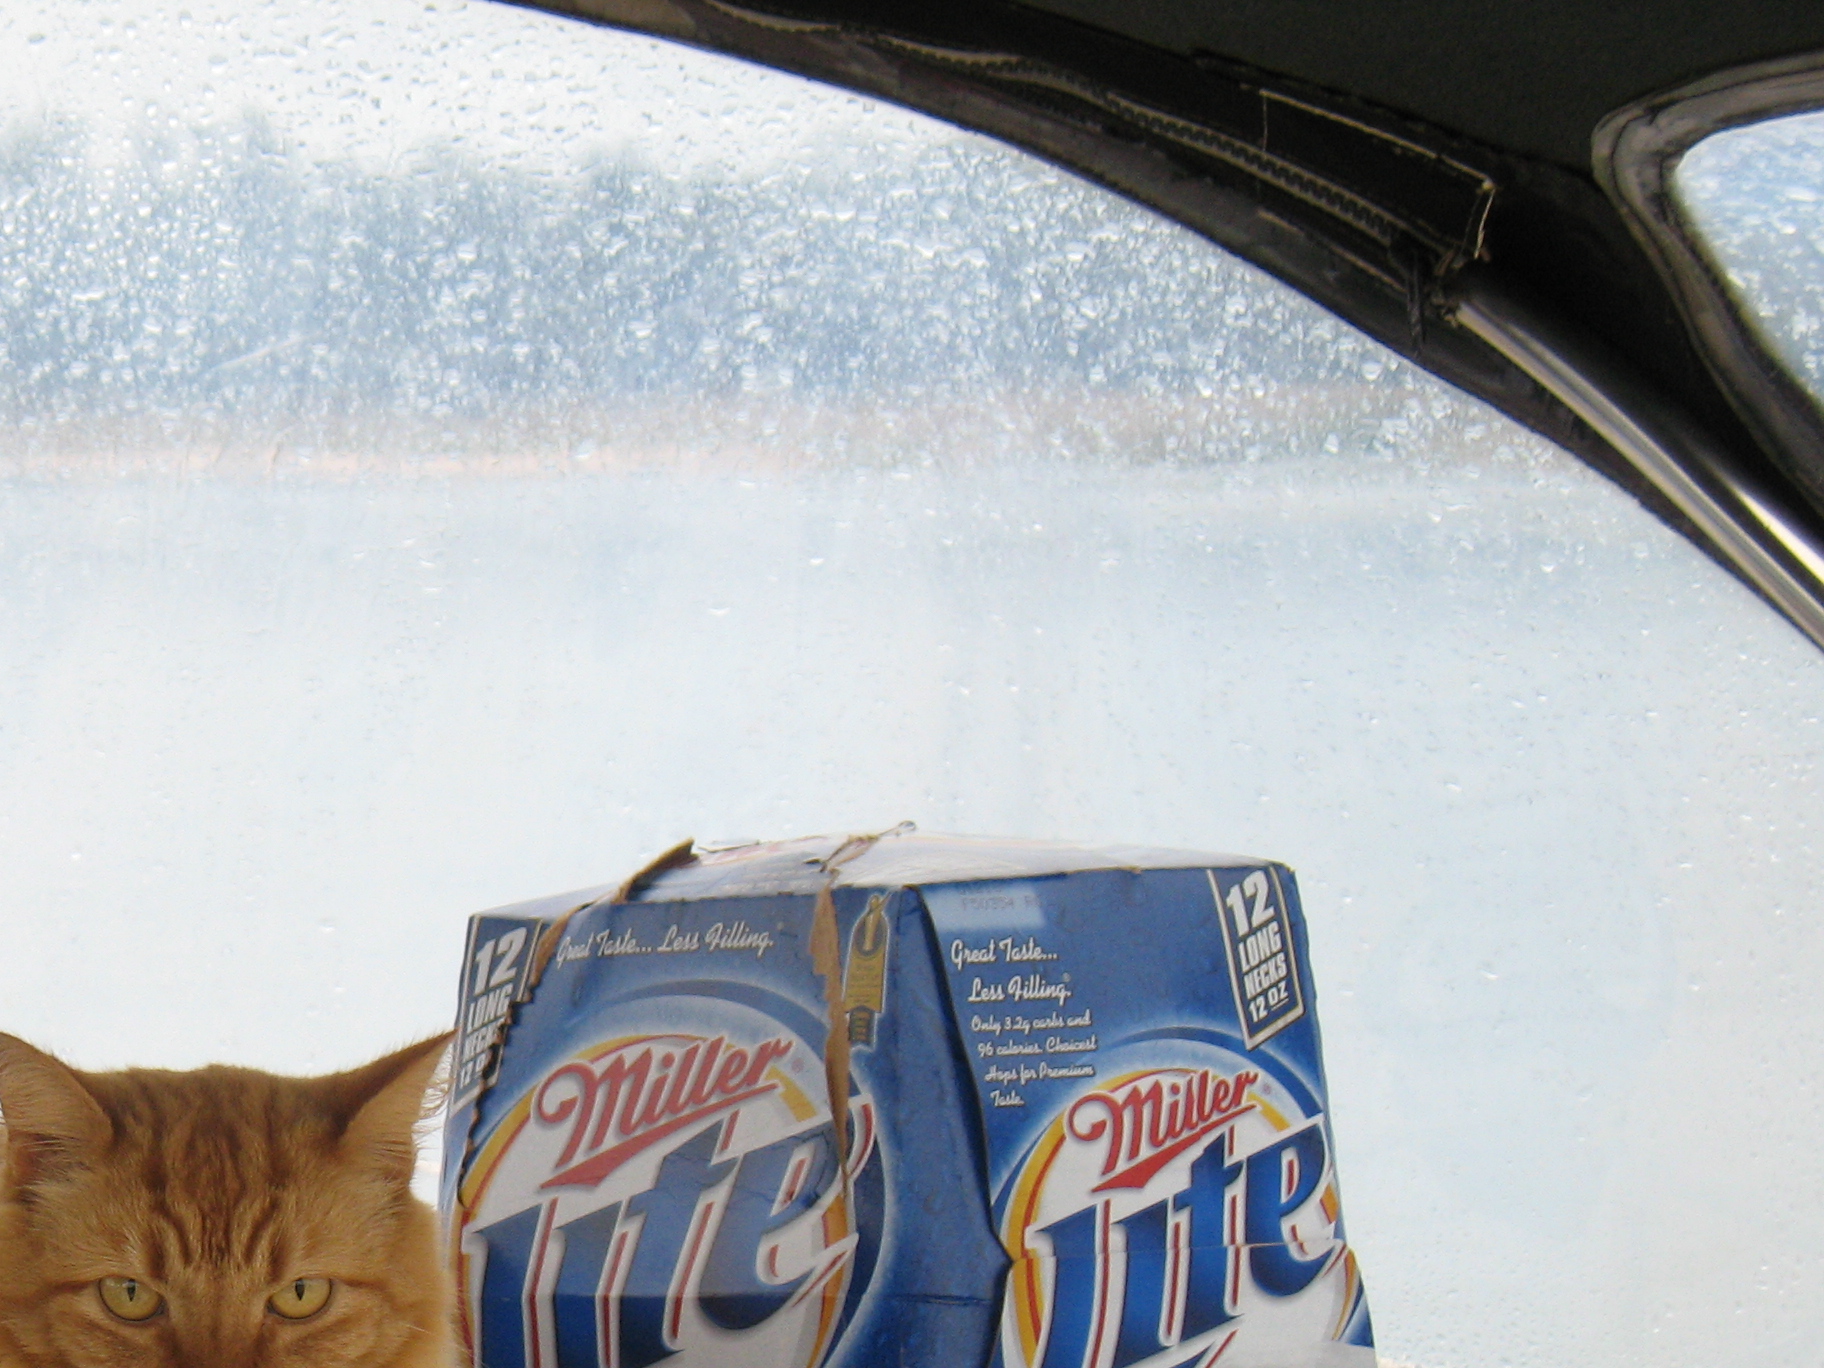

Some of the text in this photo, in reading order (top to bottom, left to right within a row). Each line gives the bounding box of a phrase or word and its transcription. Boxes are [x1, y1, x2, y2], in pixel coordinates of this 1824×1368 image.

[1226, 870, 1275, 937] 12
[473, 927, 527, 997] 12
[556, 936, 593, 969] Great
[657, 924, 700, 951] Less
[951, 939, 995, 970] Great
[1238, 921, 1282, 973] LONG
[968, 976, 1005, 1002] Less
[1243, 952, 1287, 1000] NECKS
[466, 983, 513, 1035] LONG
[971, 1014, 1001, 1036] Only
[1066, 1008, 1092, 1027] and
[1248, 981, 1288, 1023] 12 OZ
[977, 1041, 993, 1058] 96
[1038, 1060, 1095, 1080] Premium
[537, 1035, 794, 1175] Miller
[1067, 1068, 1258, 1182] Miller
